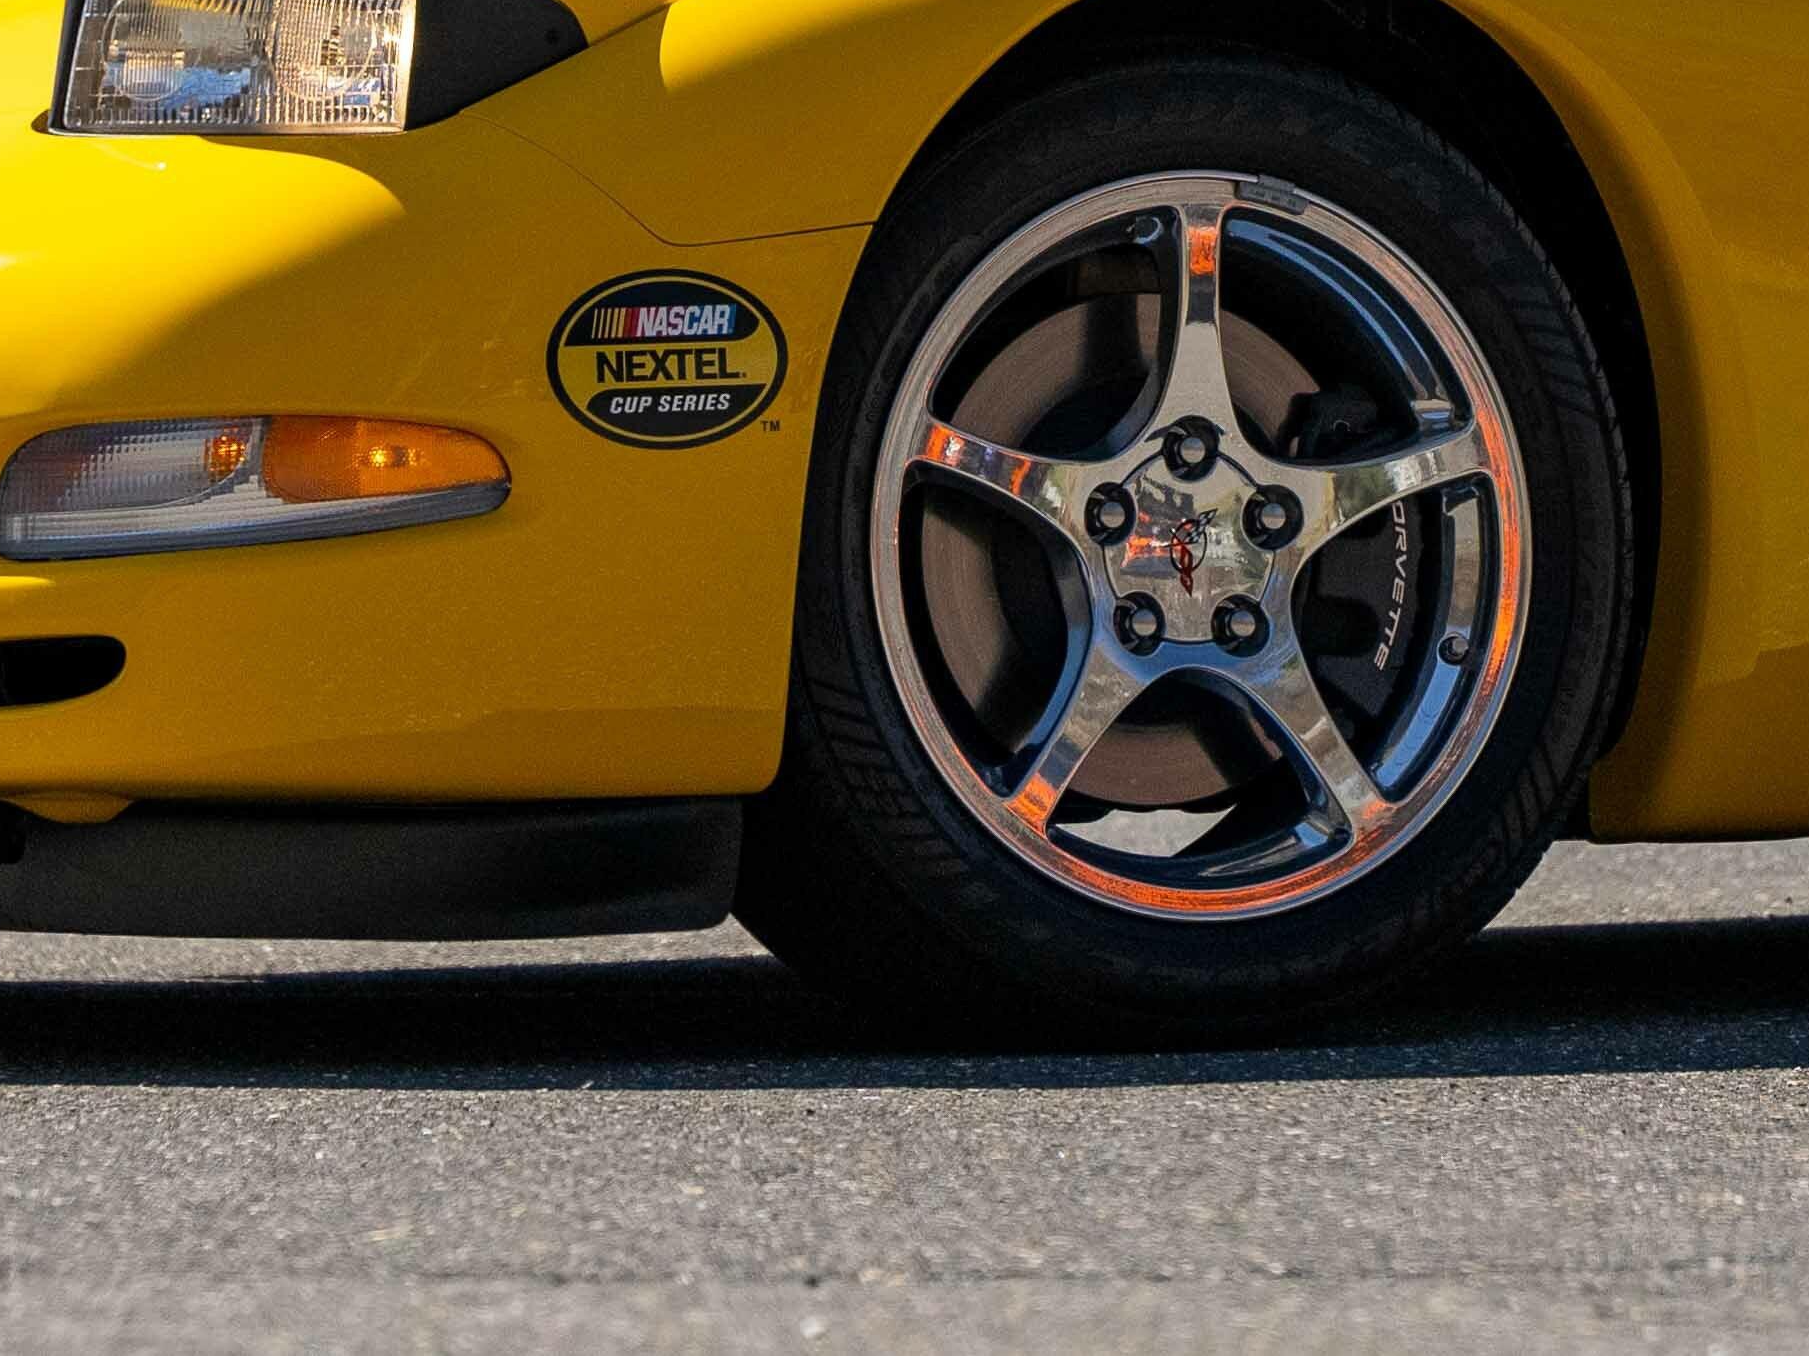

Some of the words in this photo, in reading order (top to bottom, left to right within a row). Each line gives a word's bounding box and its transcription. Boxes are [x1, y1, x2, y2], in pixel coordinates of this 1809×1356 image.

[635, 303, 735, 338] NASCAR
[609, 394, 652, 414] CUP
[657, 392, 732, 413] SERIES
[760, 420, 781, 432] TM
[1373, 500, 1409, 672] ORVETTE
